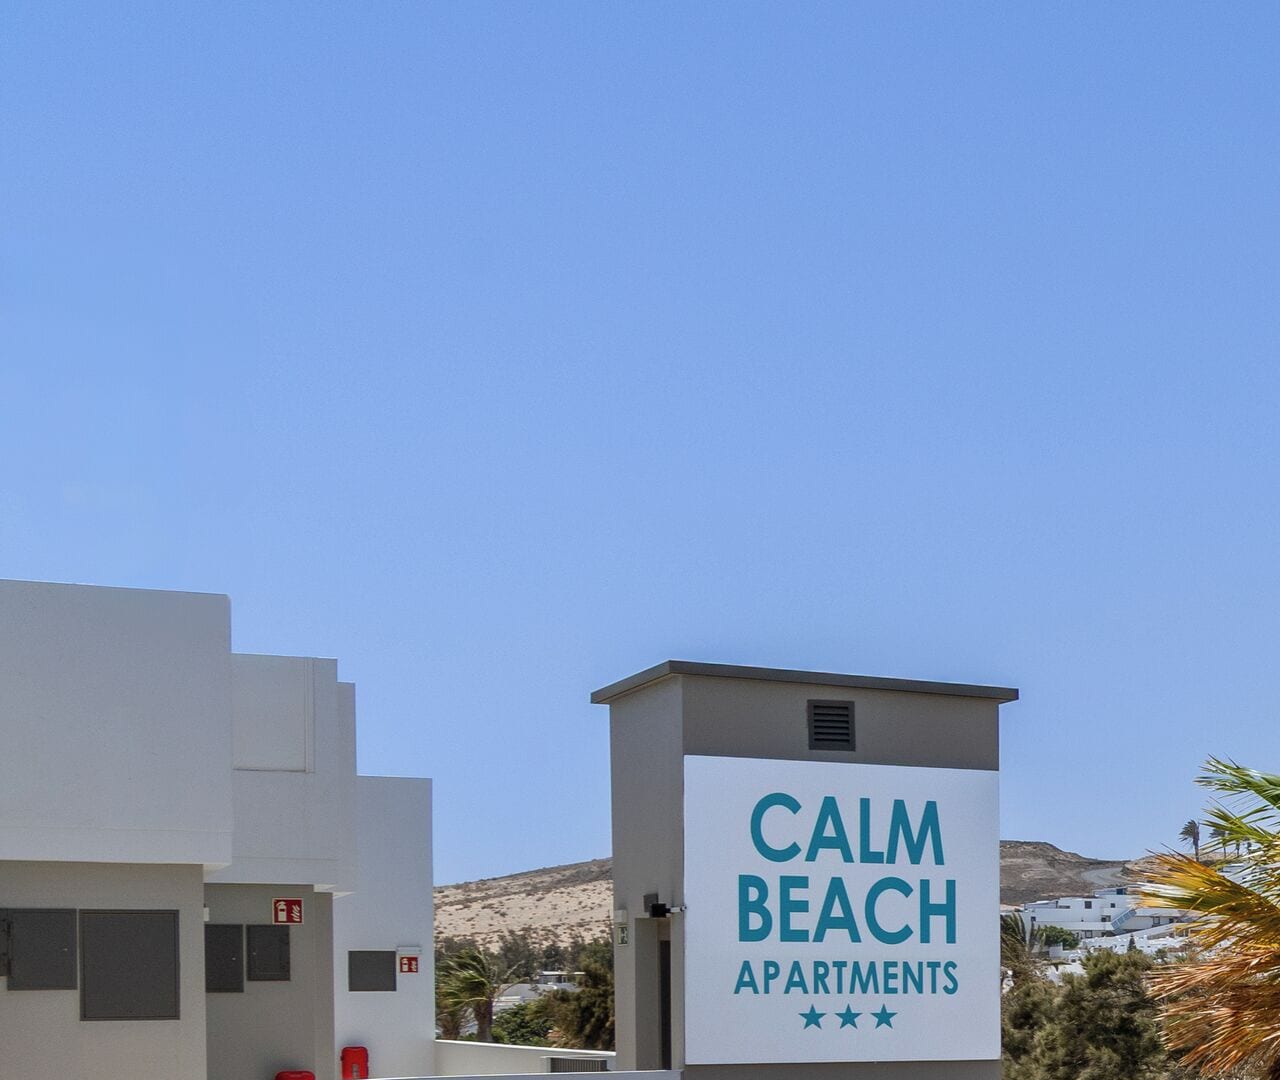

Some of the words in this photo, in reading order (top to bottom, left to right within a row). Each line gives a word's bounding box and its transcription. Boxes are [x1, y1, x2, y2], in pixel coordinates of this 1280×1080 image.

[750, 792, 945, 866] CALM
[737, 874, 957, 945] BEACH
[733, 959, 959, 995] APARTMENTS
